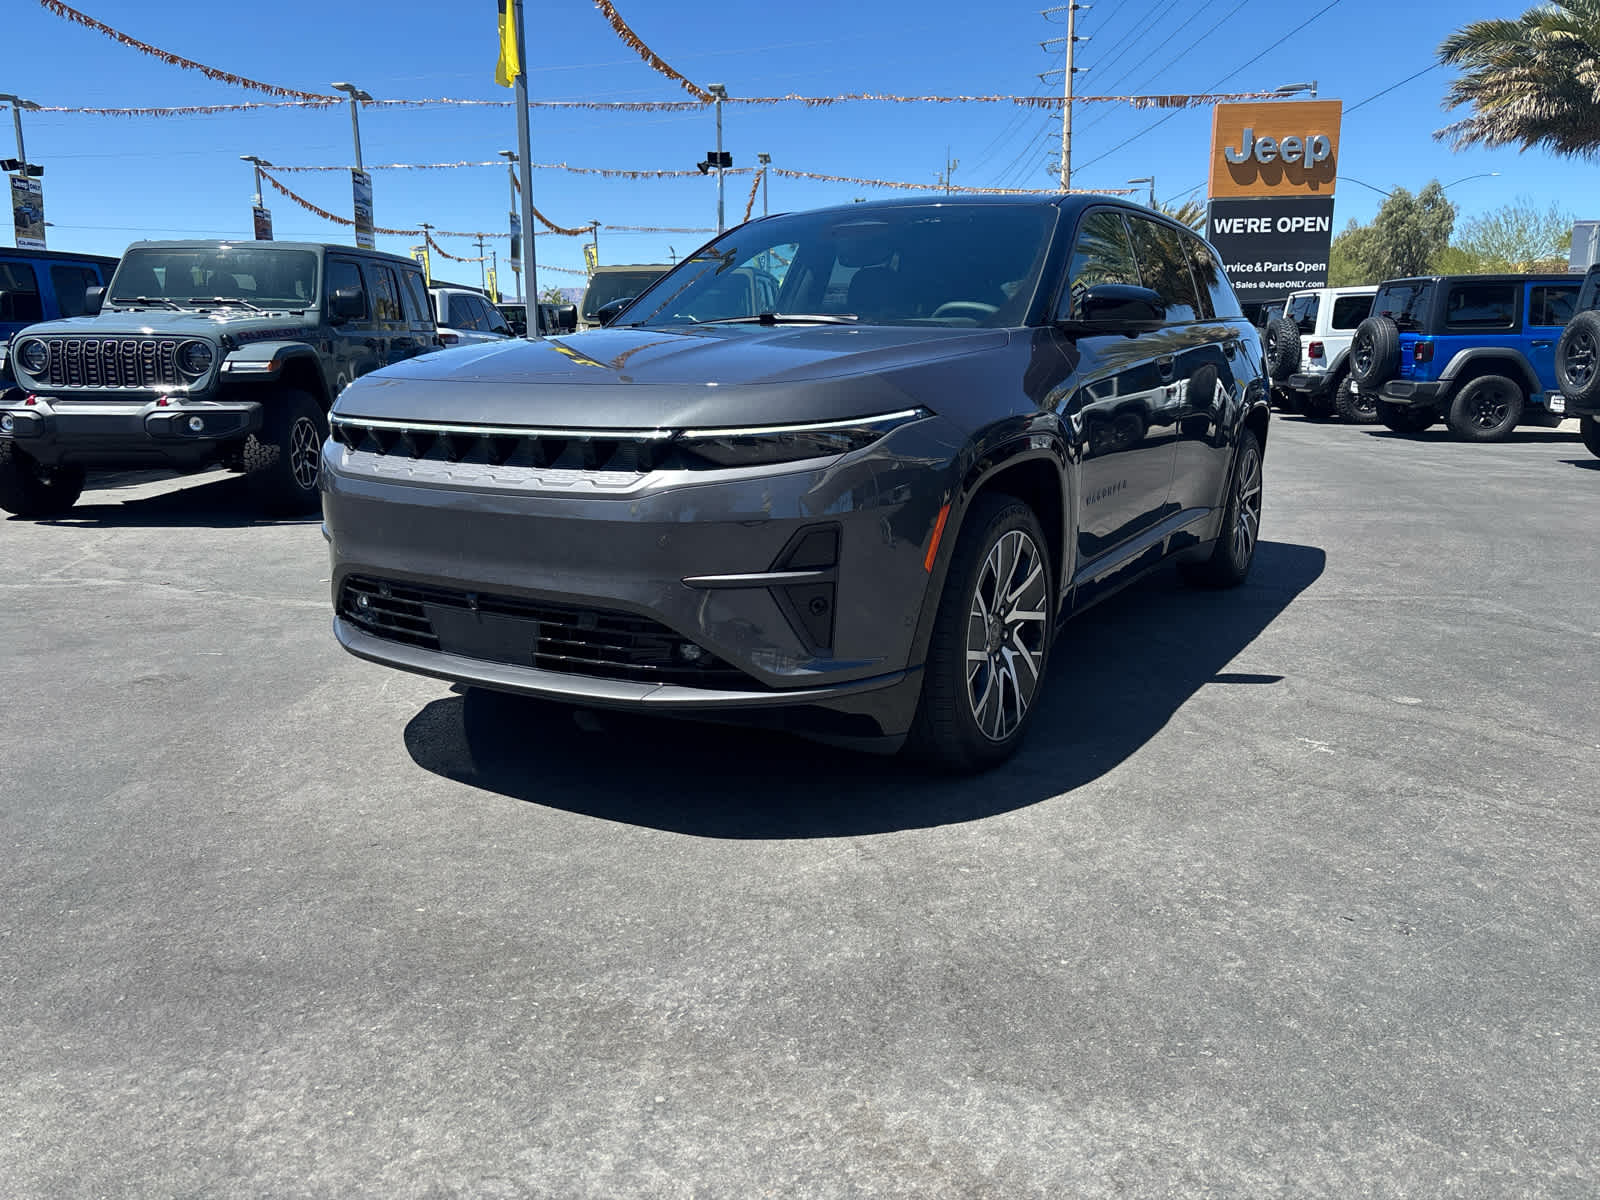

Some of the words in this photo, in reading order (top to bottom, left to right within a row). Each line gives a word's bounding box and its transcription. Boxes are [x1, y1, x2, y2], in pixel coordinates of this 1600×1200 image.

[1224, 128, 1330, 168] Jeep
[1214, 217, 1272, 233] WE'RE
[1276, 216, 1329, 233] OPEN
[1222, 261, 1254, 272] ervice
[1254, 262, 1263, 272] &
[1263, 261, 1294, 272] Parts
[1295, 261, 1326, 273] Open
[1235, 281, 1257, 289] Sales
